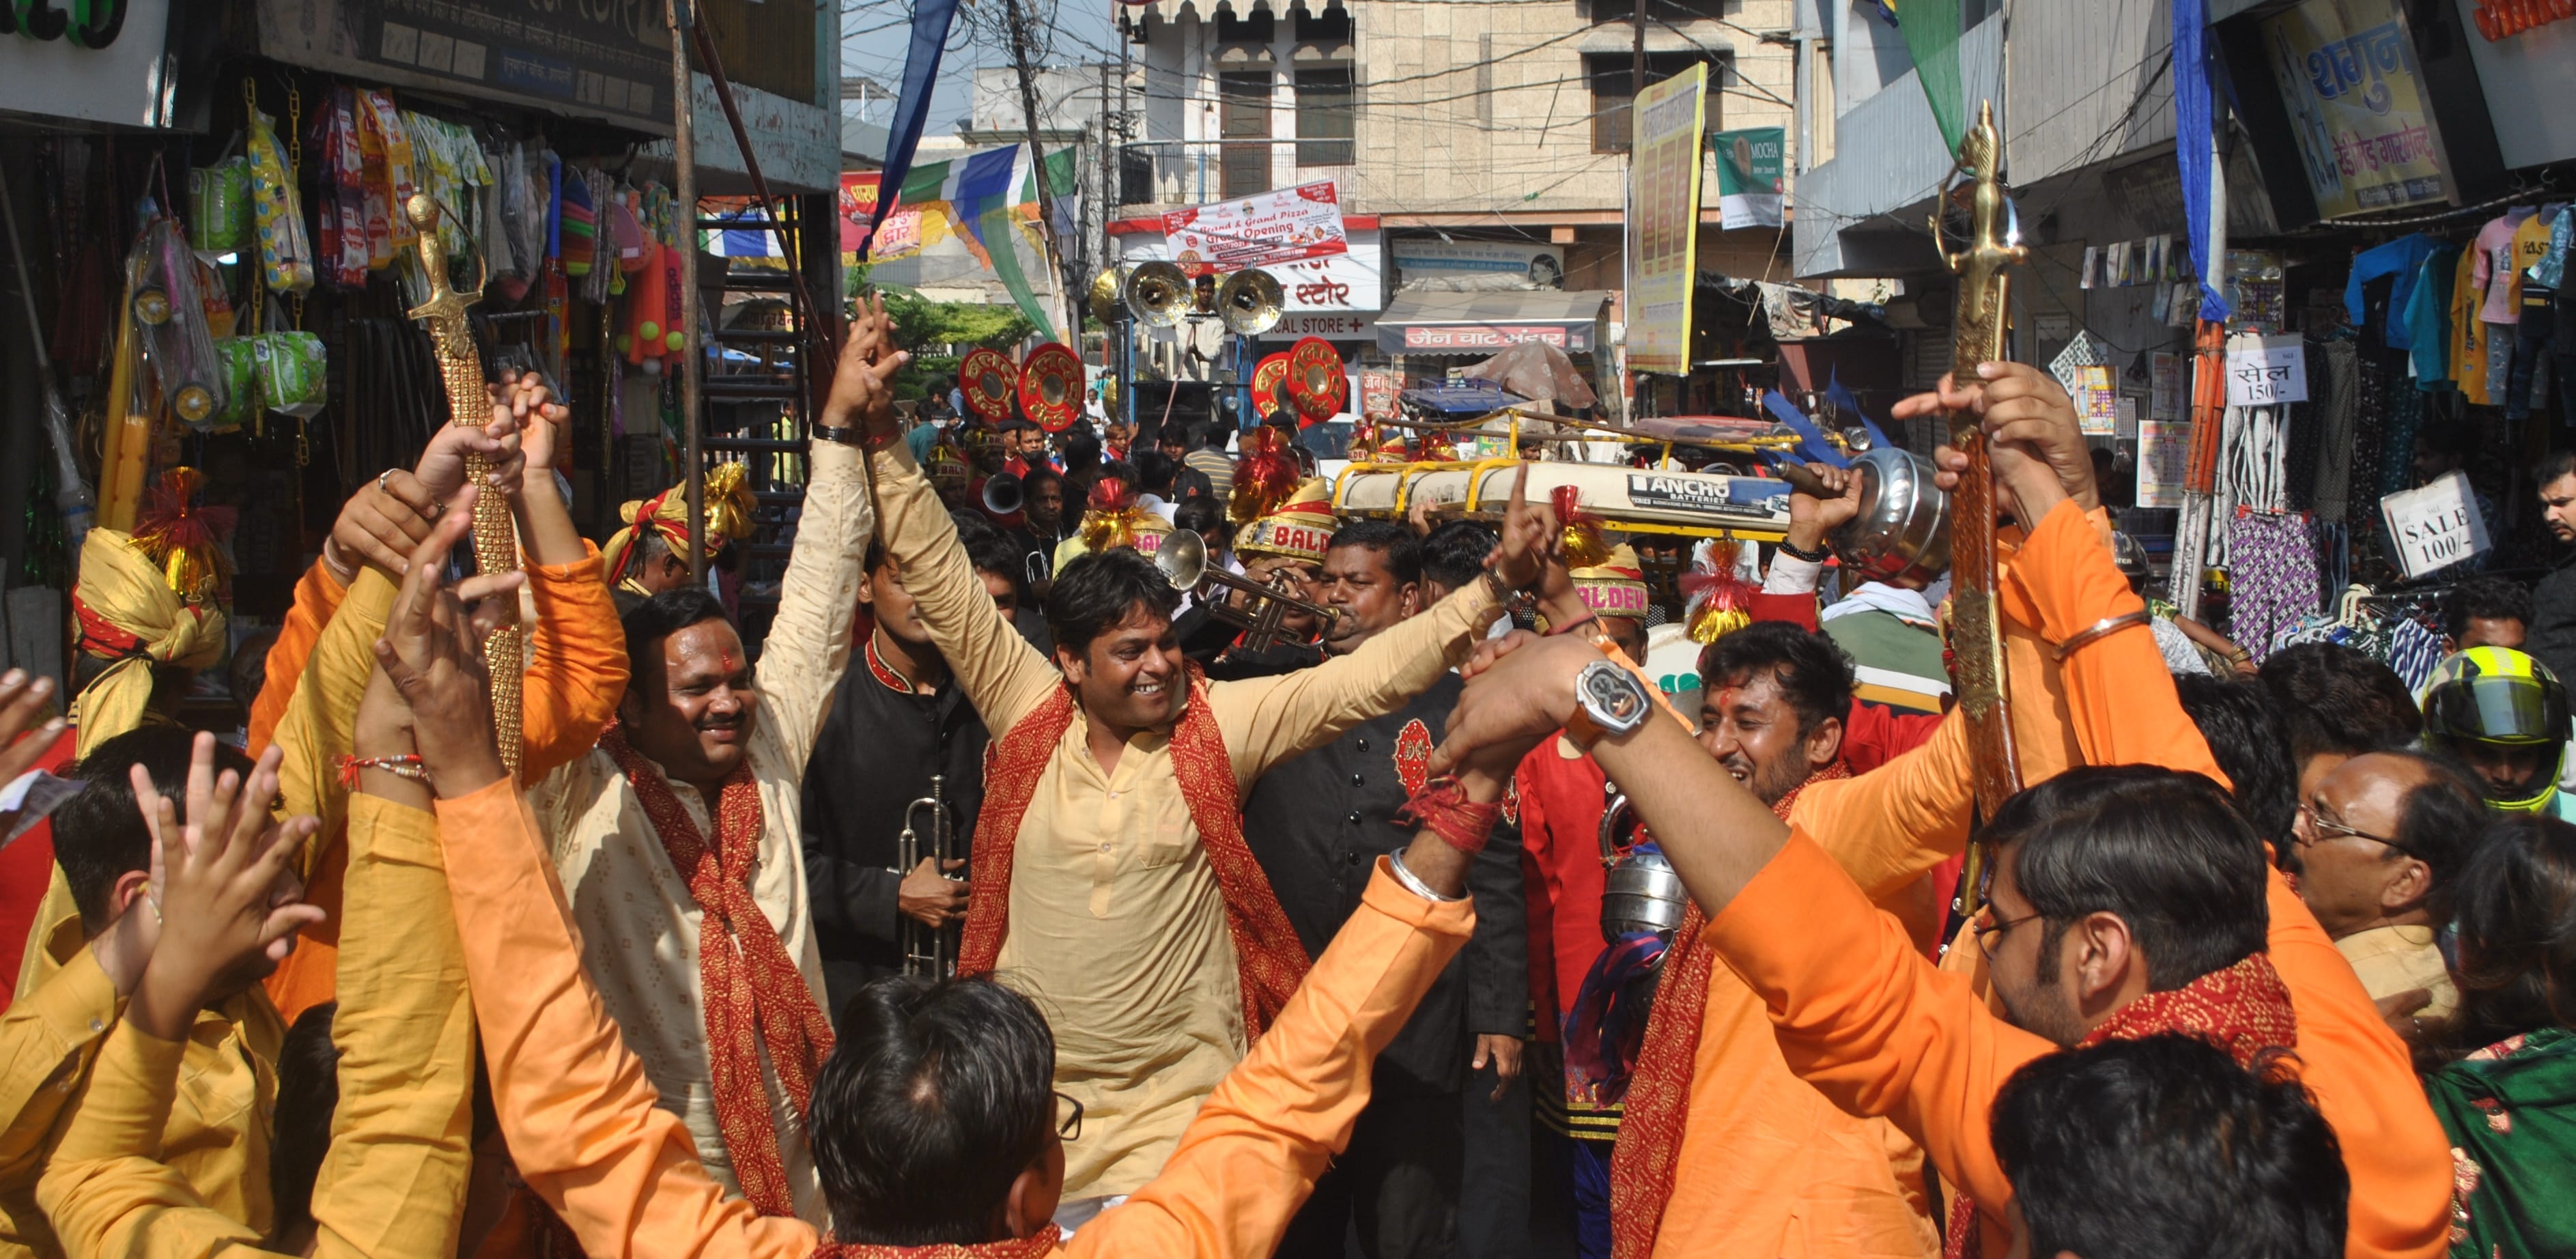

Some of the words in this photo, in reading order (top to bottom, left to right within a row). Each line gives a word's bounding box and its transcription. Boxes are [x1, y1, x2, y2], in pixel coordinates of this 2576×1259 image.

[2306, 20, 2411, 115] शगुन
[1750, 142, 1779, 159] MOCHA
[1200, 222, 1230, 234] Grand
[1245, 214, 1277, 227] Grand
[1280, 209, 1309, 219] Pizza
[1206, 231, 1239, 244] Grand
[1244, 223, 1294, 239] Opening
[668, 267, 682, 320] adidas
[1296, 275, 1350, 306] स्टोर
[1266, 318, 1297, 334] ICAL
[1302, 317, 1344, 334] STORE
[1407, 328, 1452, 345] जैन
[1458, 333, 1499, 345] चाट
[1363, 371, 1381, 389] जैन
[2234, 363, 2291, 383] सेल
[2248, 382, 2286, 400] 150/-
[941, 466, 965, 475] BALD
[1650, 476, 1729, 498] ANCHO
[1669, 492, 1725, 505] BATTERIES
[2405, 507, 2470, 544] SALE
[1133, 534, 1161, 552] BAL
[1274, 525, 1331, 554] BALD
[2421, 532, 2471, 563] 100/-
[1577, 586, 1643, 610] ALDEV
